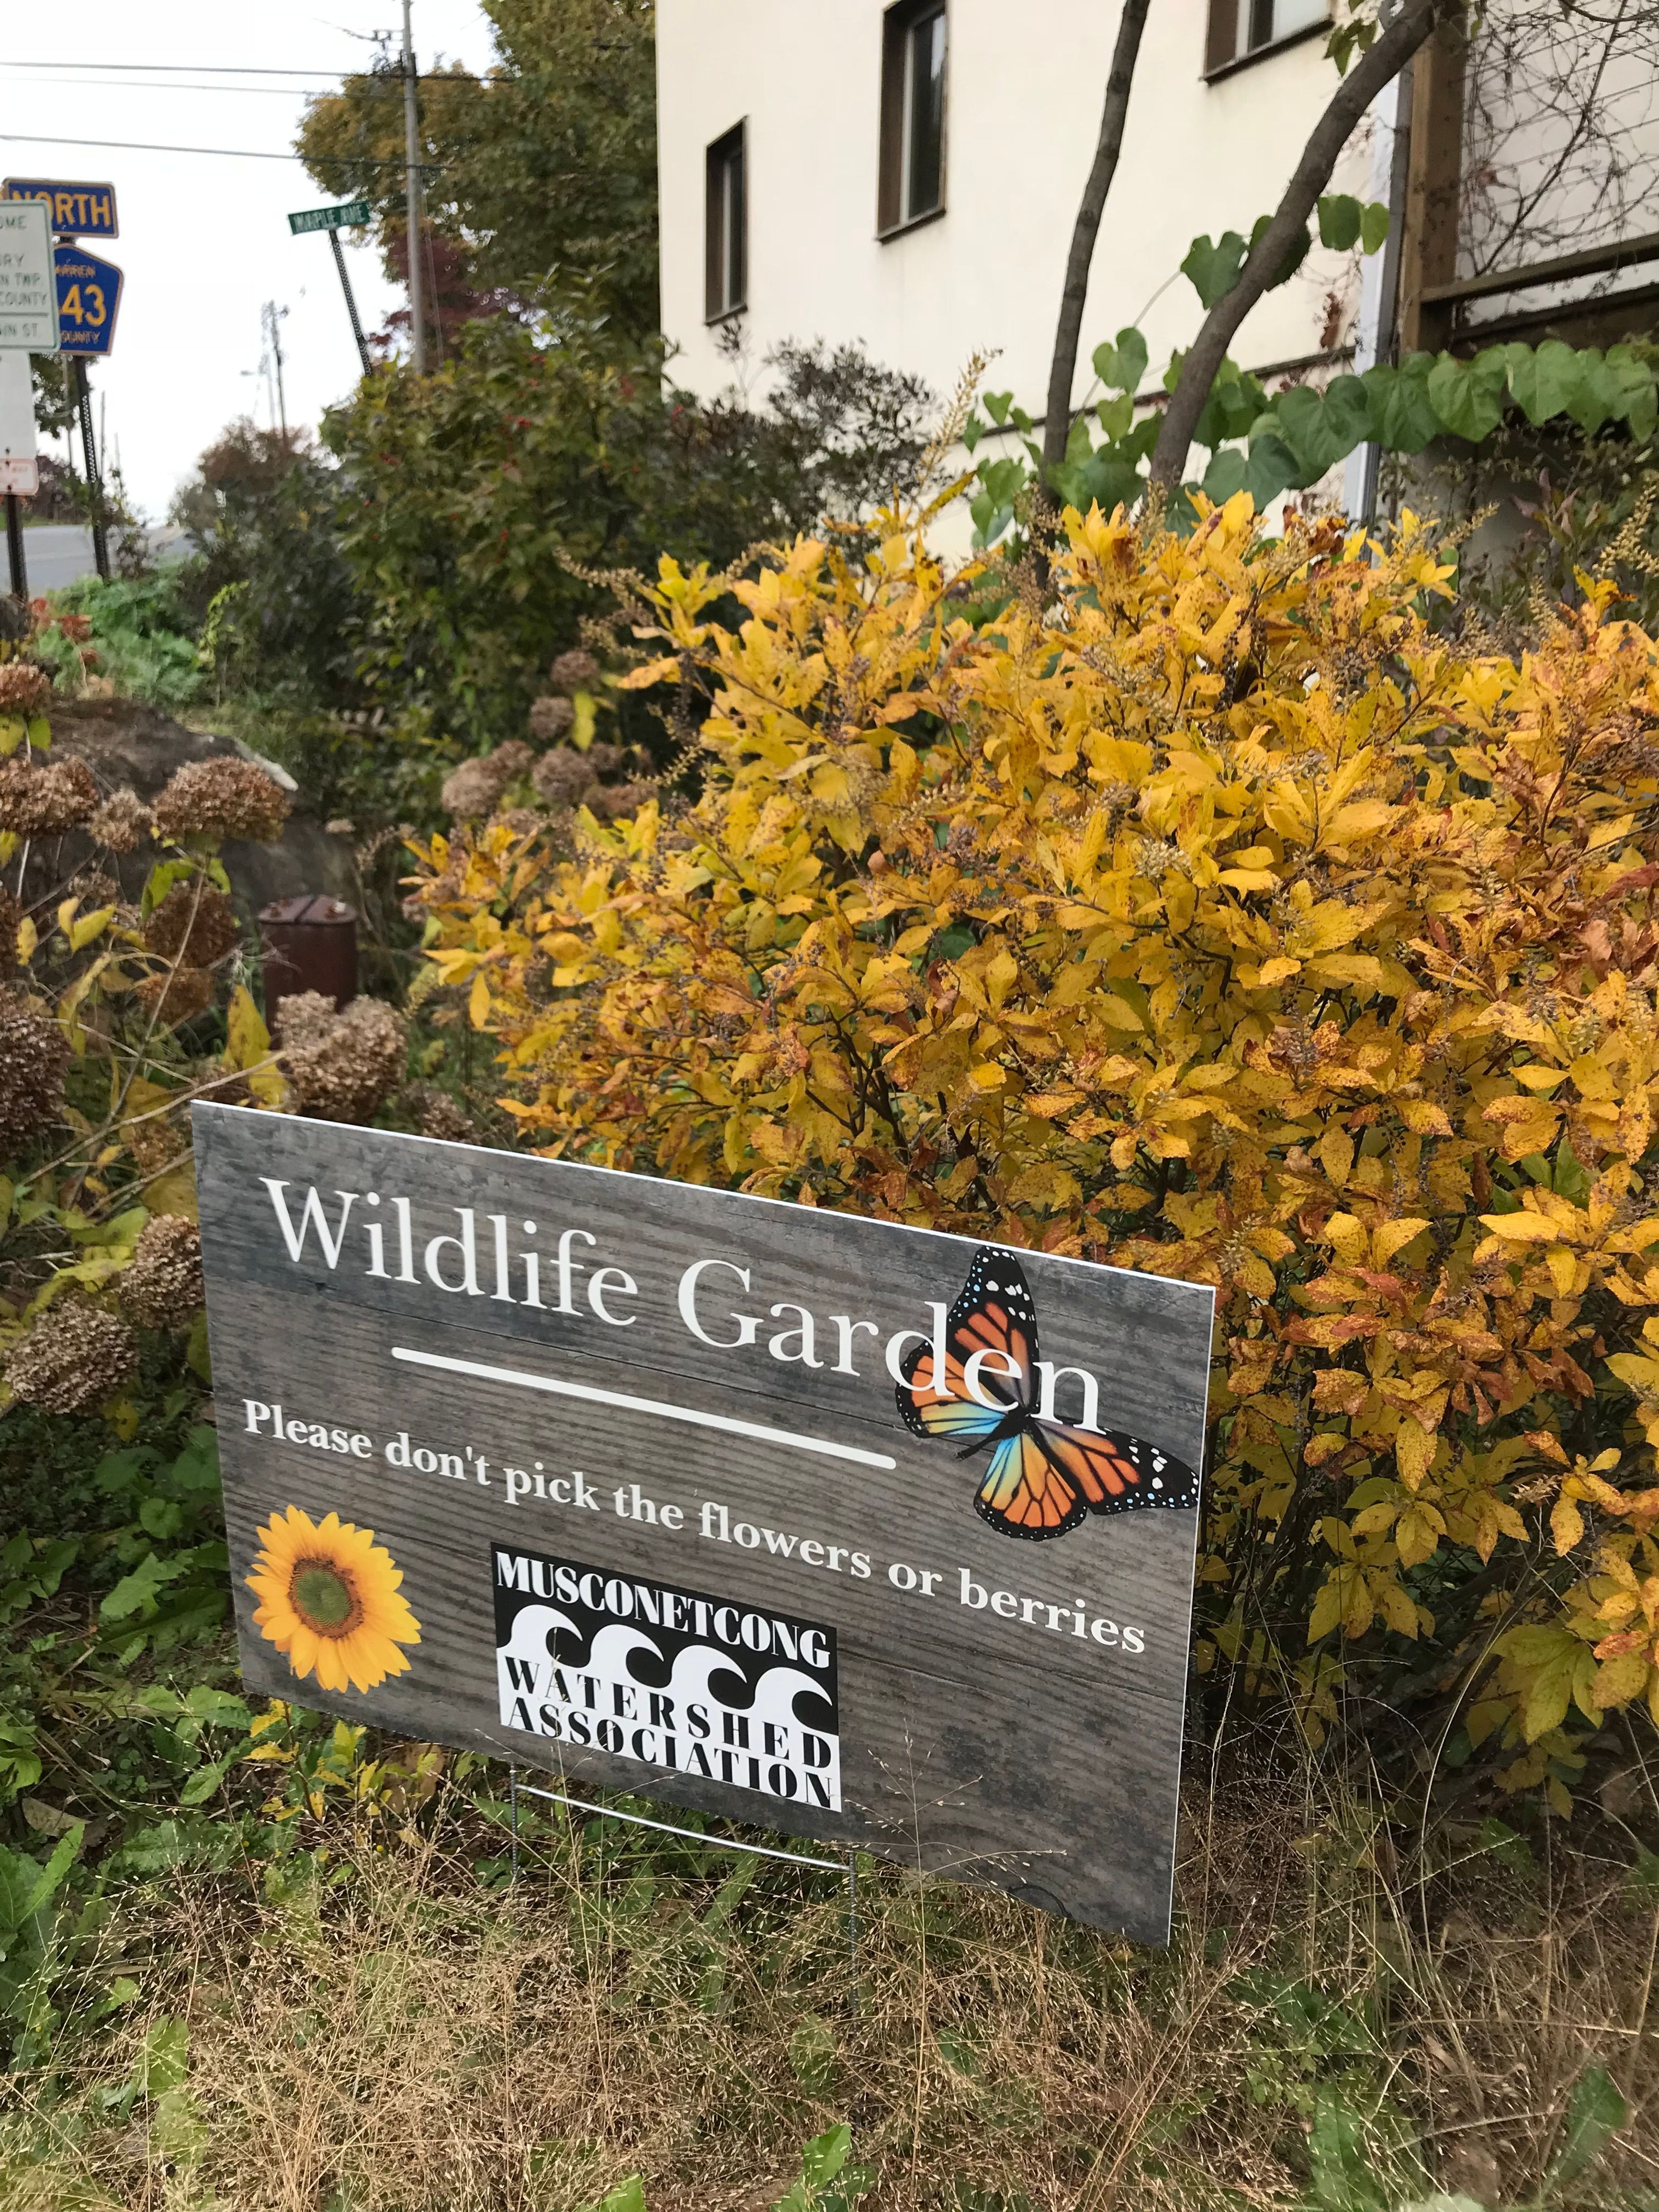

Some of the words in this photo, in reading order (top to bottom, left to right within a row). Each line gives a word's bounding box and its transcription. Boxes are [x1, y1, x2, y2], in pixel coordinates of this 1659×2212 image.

[0, 254, 25, 267] RY
[12, 190, 111, 227] ORTH
[61, 330, 100, 344] OUNTY
[259, 1177, 639, 1325] Wildlife
[678, 1259, 1107, 1435] Garden
[242, 1398, 373, 1459] Please
[385, 1432, 492, 1486] don't
[502, 1461, 601, 1511] pick
[613, 1484, 684, 1530] the
[698, 1501, 871, 1578] flowers
[888, 1563, 943, 1597] or
[958, 1567, 1145, 1654] berries
[495, 1551, 831, 1669] MUSCONETCONG
[505, 1656, 832, 1769] WATERSHED
[508, 1697, 832, 1809] ASSOCIATION
